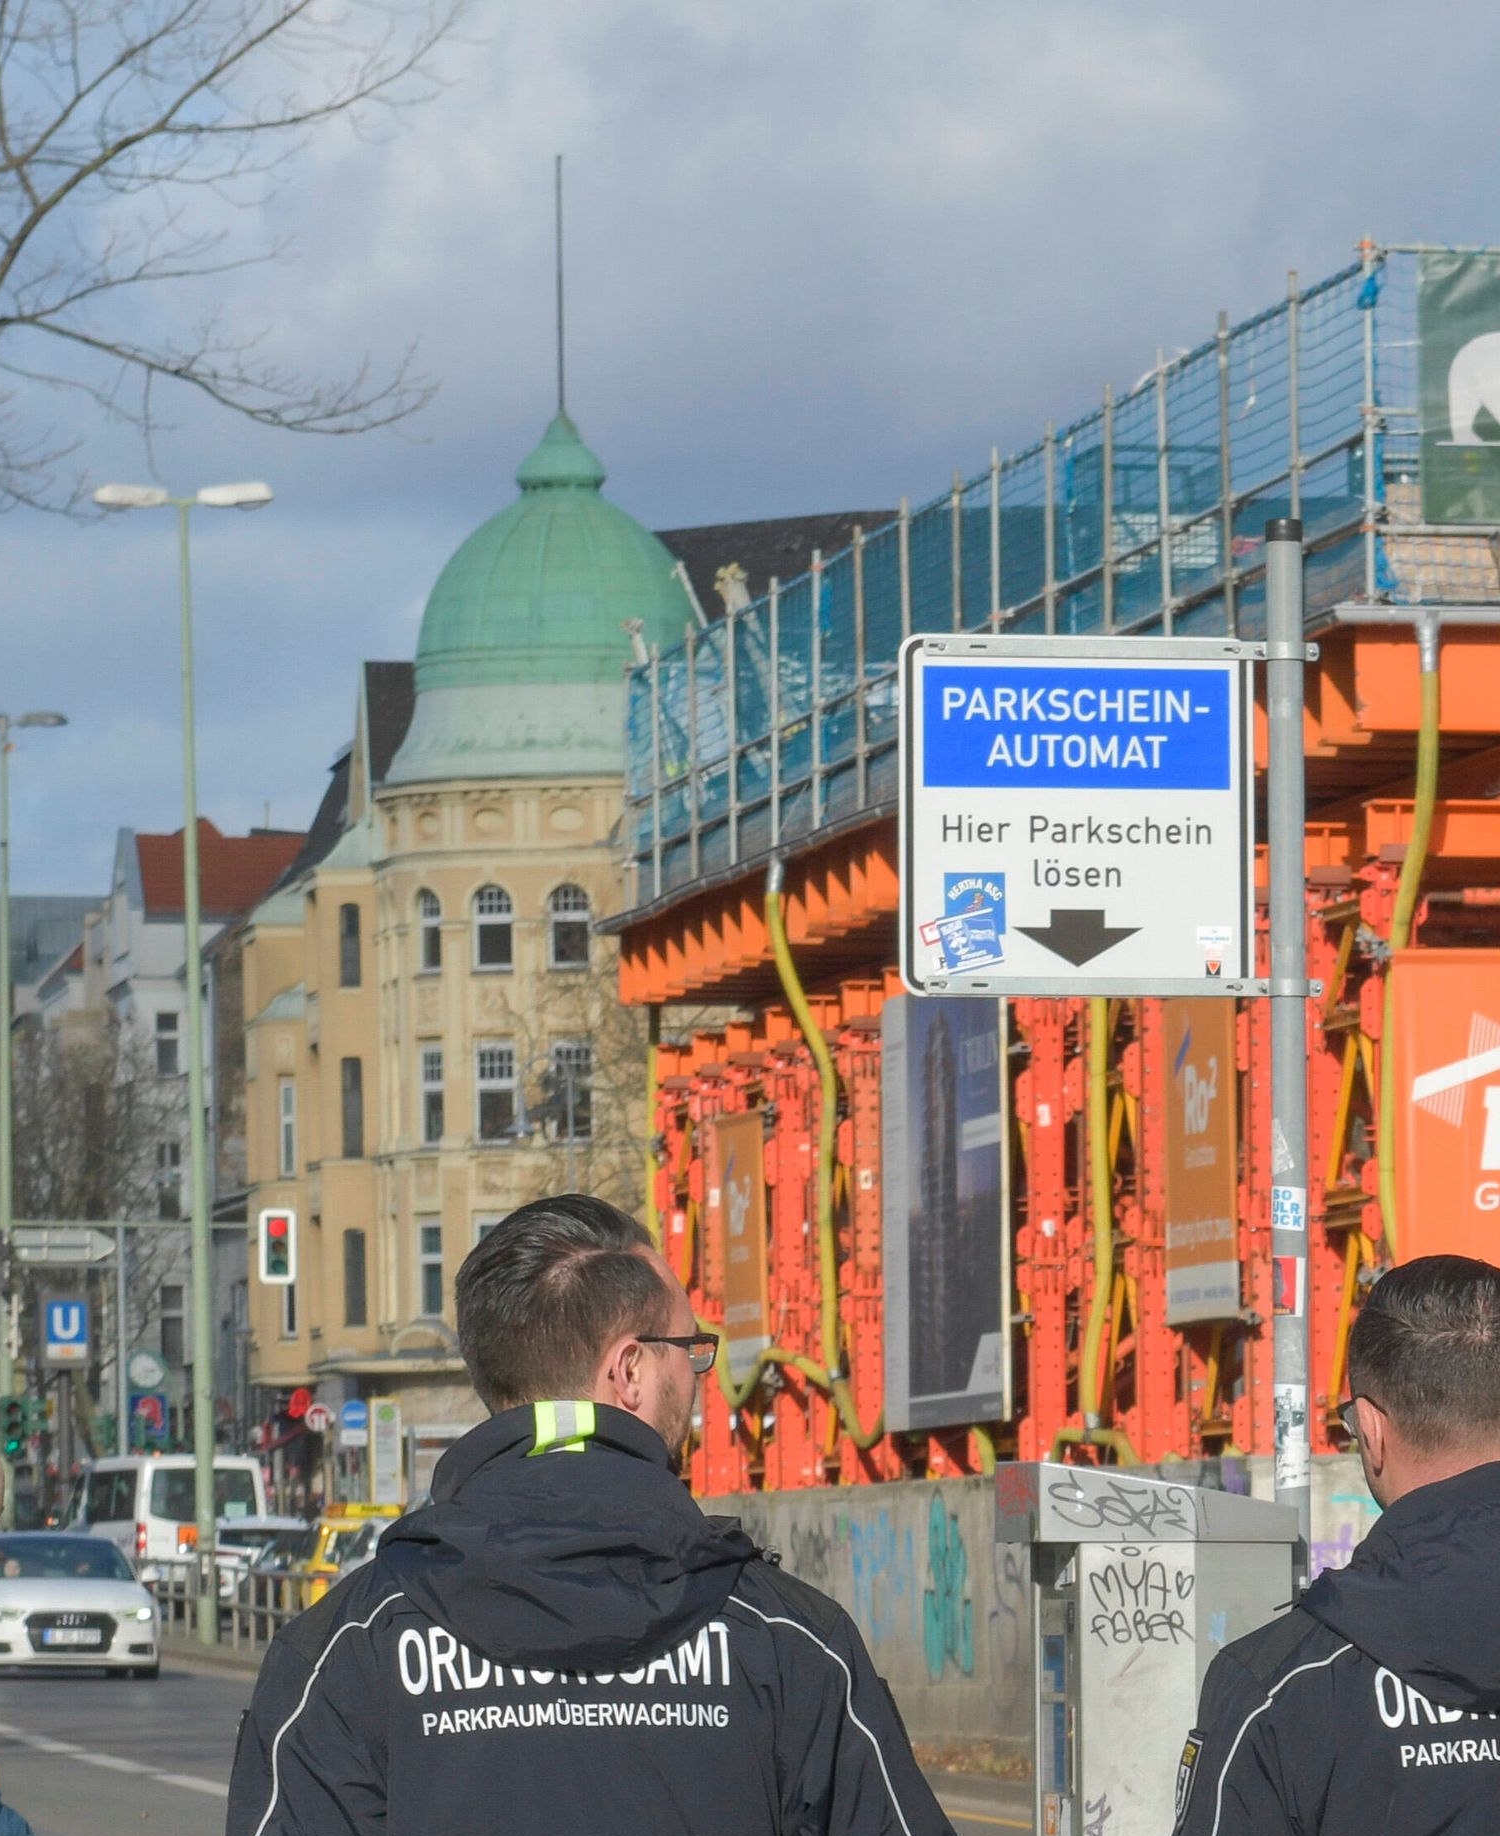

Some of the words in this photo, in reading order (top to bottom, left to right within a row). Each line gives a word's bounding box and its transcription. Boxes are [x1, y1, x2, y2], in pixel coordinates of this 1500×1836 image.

[942, 686, 1211, 723] PARKSCHEIN-
[986, 733, 1168, 769] AUTOMAT
[942, 814, 1011, 844] Hier
[1029, 815, 1213, 845] Parkschein
[948, 878, 983, 901] HERTHA
[984, 881, 1003, 901] BSC
[1033, 859, 1122, 889] lösen
[52, 1306, 81, 1340] U
[422, 1699, 730, 1737] PARKRAUMÜBERWACHUNG
